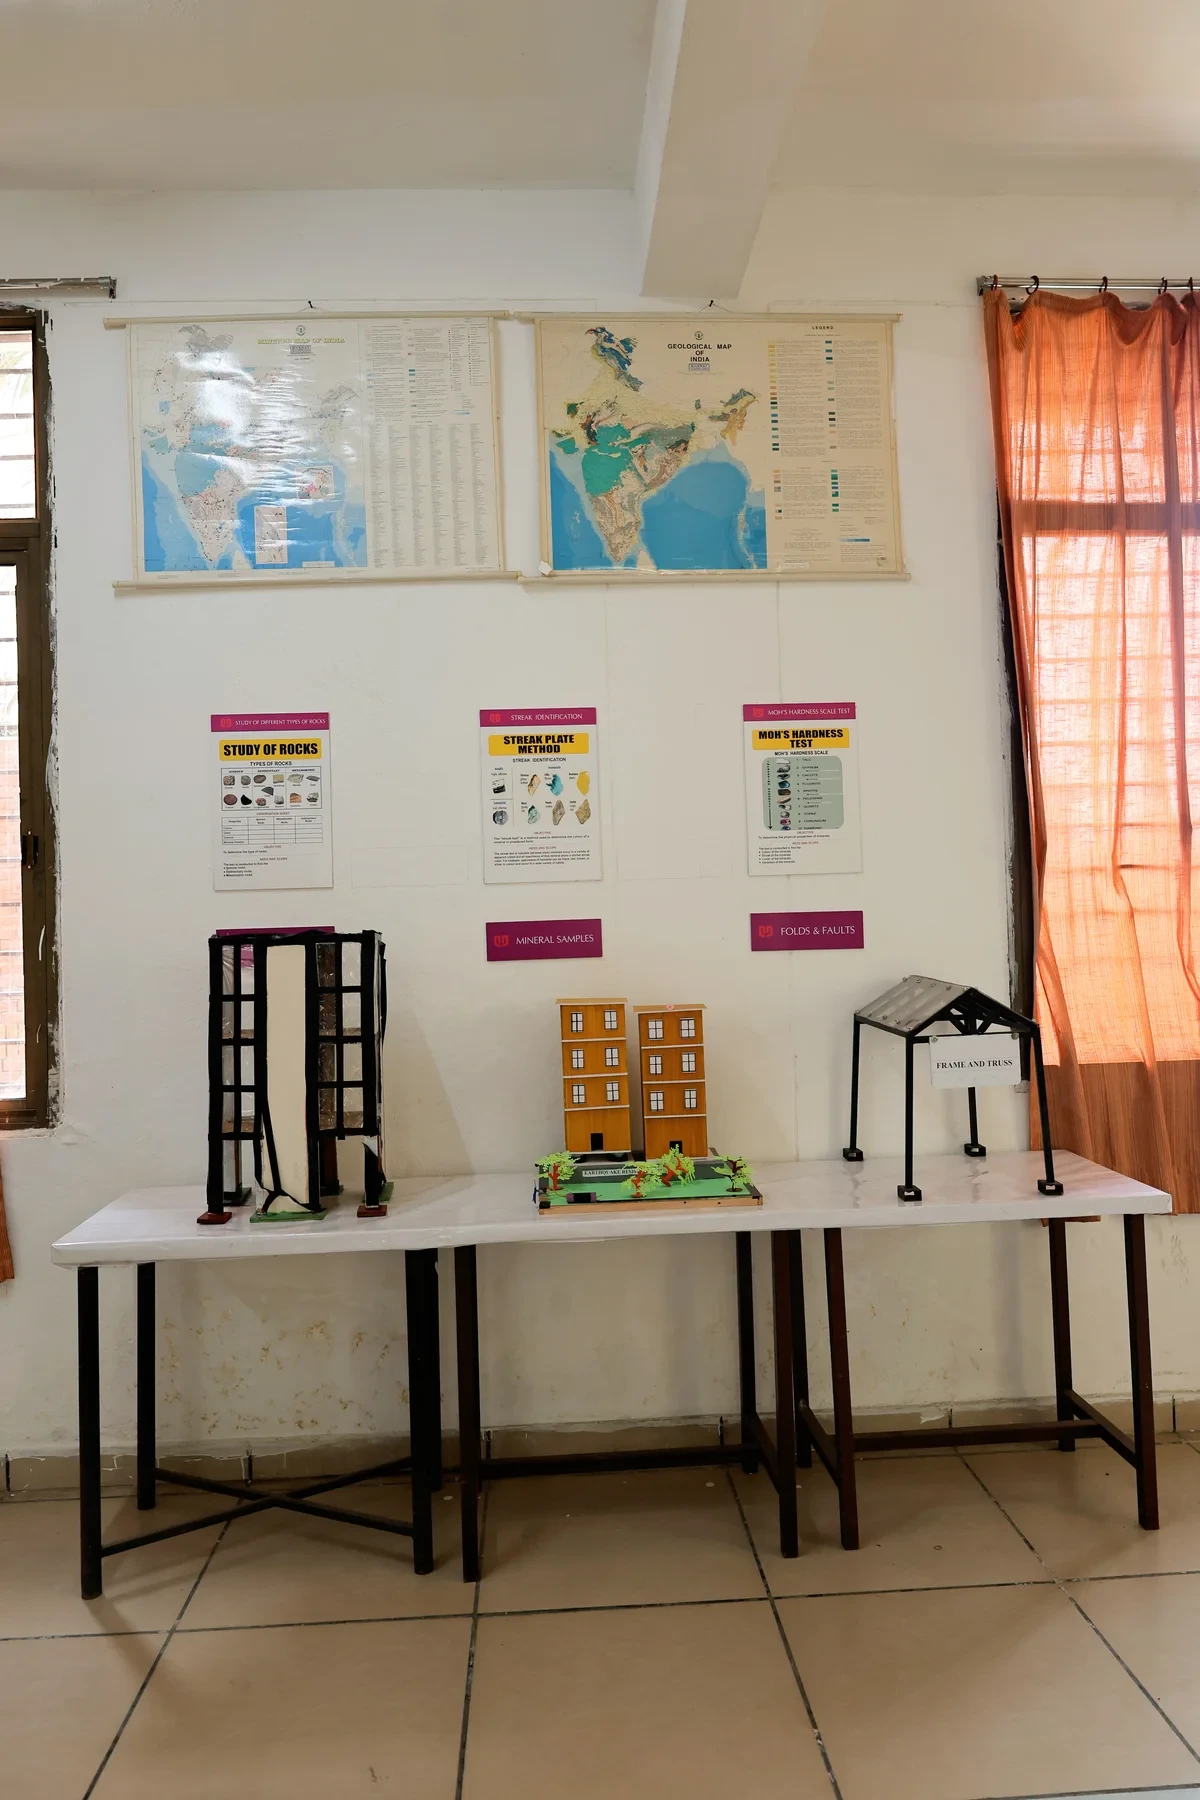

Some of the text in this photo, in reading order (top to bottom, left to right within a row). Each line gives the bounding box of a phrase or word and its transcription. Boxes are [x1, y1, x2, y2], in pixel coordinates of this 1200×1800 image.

[758, 729, 843, 739] MOH'S HARDNESS
[504, 734, 574, 745] STREAK PLATE
[790, 739, 813, 748] TEST
[224, 743, 318, 756] STUDY OF ROCKS
[518, 744, 560, 754] METHOD
[781, 927, 810, 936] FOLDS
[822, 926, 855, 935] FAULTS
[516, 934, 594, 945] MINERAL SAMPLES
